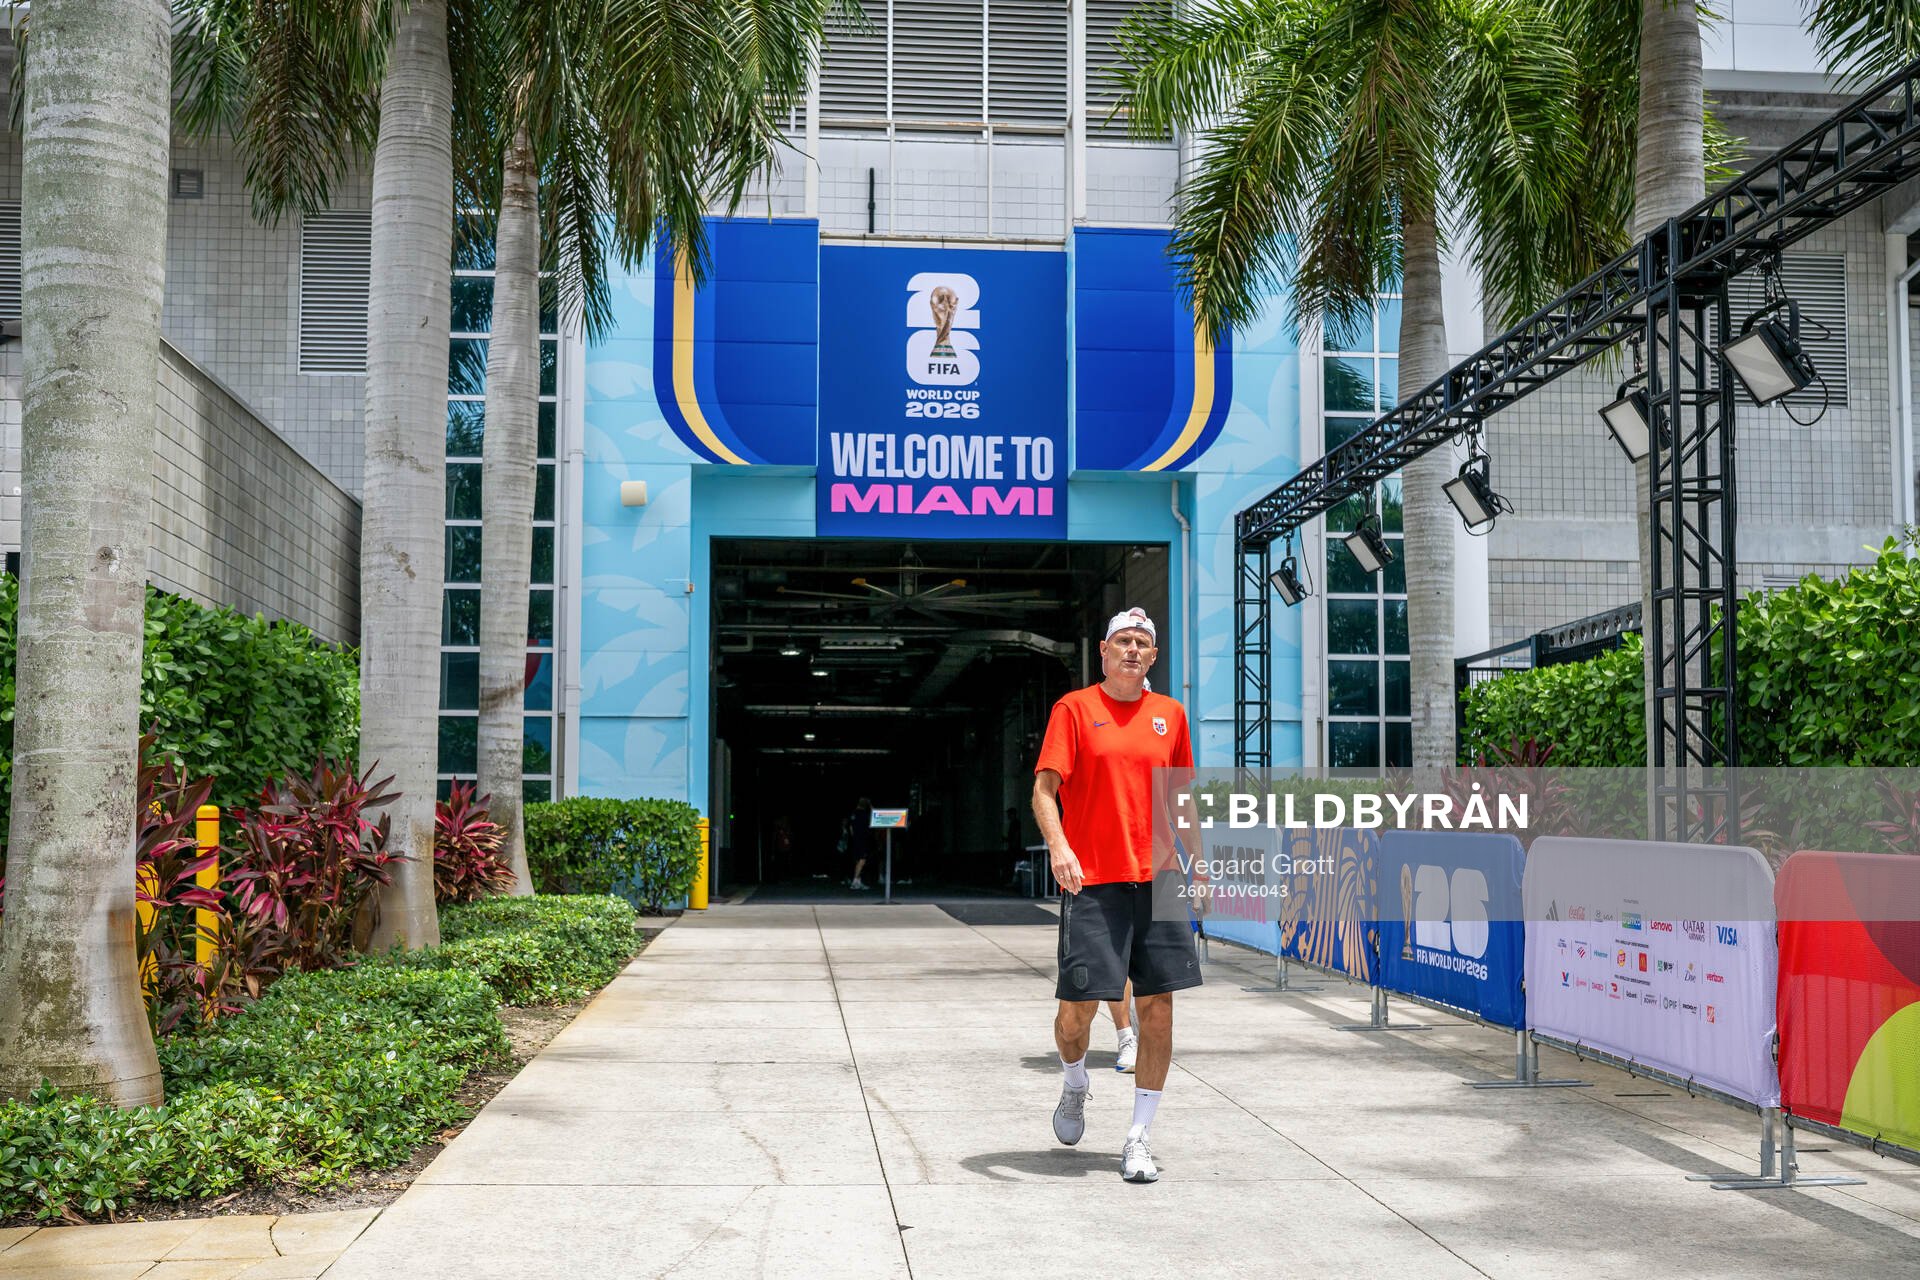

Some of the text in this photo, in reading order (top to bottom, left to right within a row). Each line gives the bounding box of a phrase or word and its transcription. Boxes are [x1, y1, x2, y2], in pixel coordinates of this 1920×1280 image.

[928, 363, 960, 375] FIFA
[906, 389, 980, 401] WORLD CUP
[905, 402, 980, 419] 2026
[831, 432, 1054, 481] WELCOME TO
[831, 483, 1054, 516] MIAMI
[1650, 919, 1673, 932] Lenovo
[1682, 919, 1705, 934] QATAR
[1716, 925, 1738, 946] VISA
[1416, 948, 1428, 965] FIFA
[1429, 951, 1452, 970] WORLD
[1453, 957, 1466, 974] CUP
